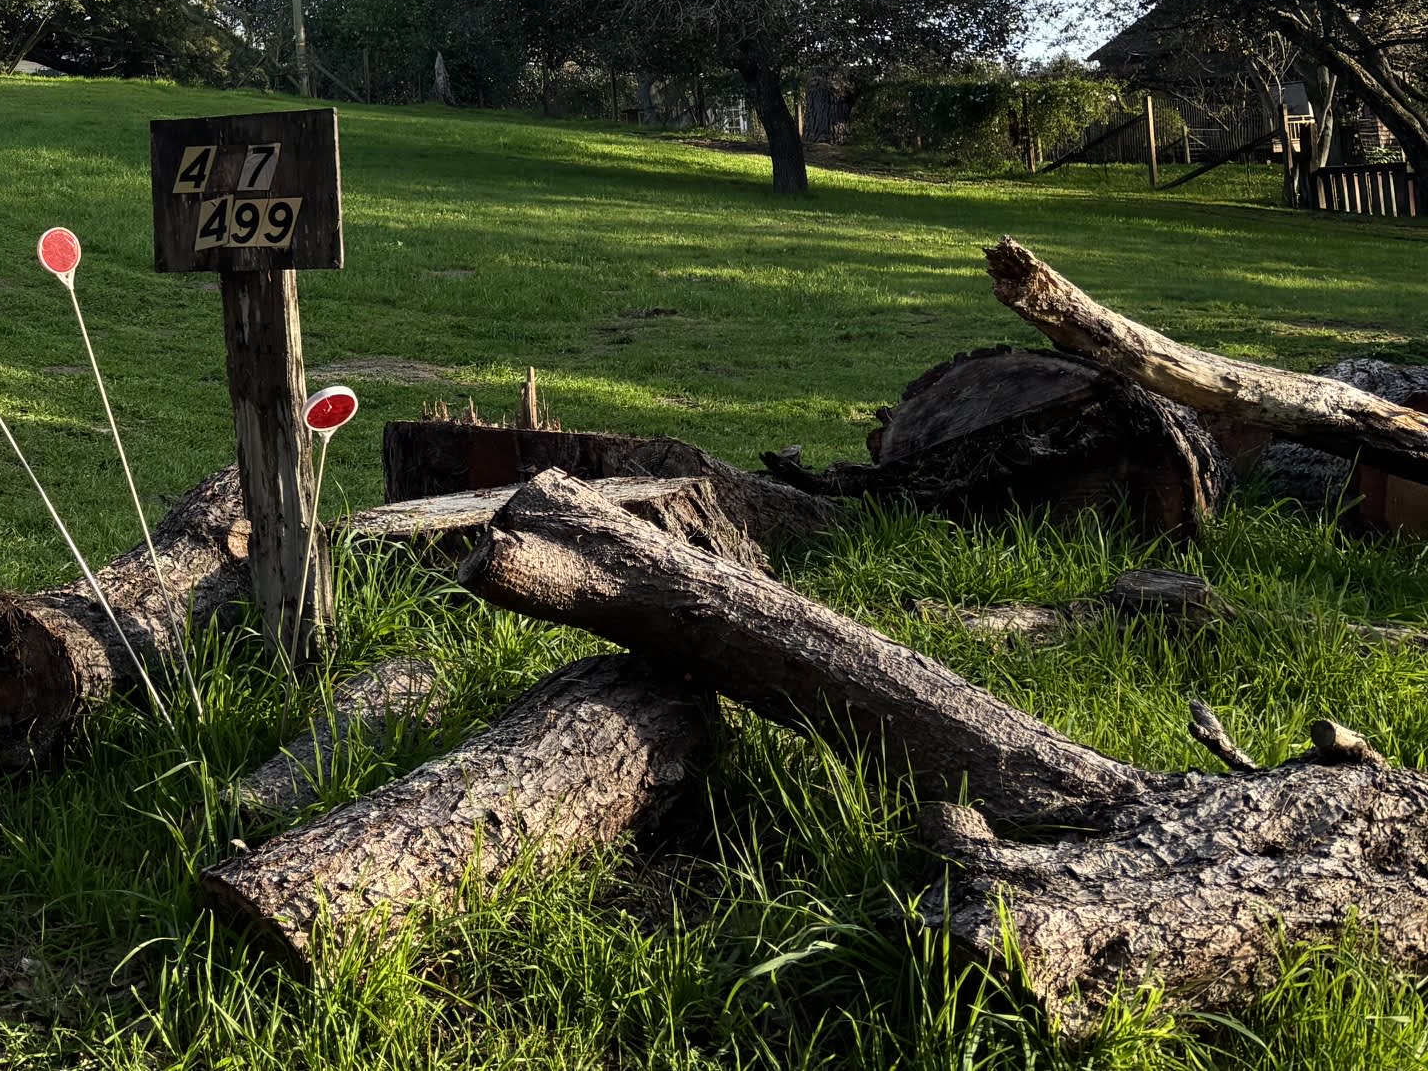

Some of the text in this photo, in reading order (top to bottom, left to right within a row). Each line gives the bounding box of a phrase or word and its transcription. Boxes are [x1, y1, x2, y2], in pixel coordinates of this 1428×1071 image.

[178, 146, 276, 189] 4 7
[199, 197, 294, 244] 499
